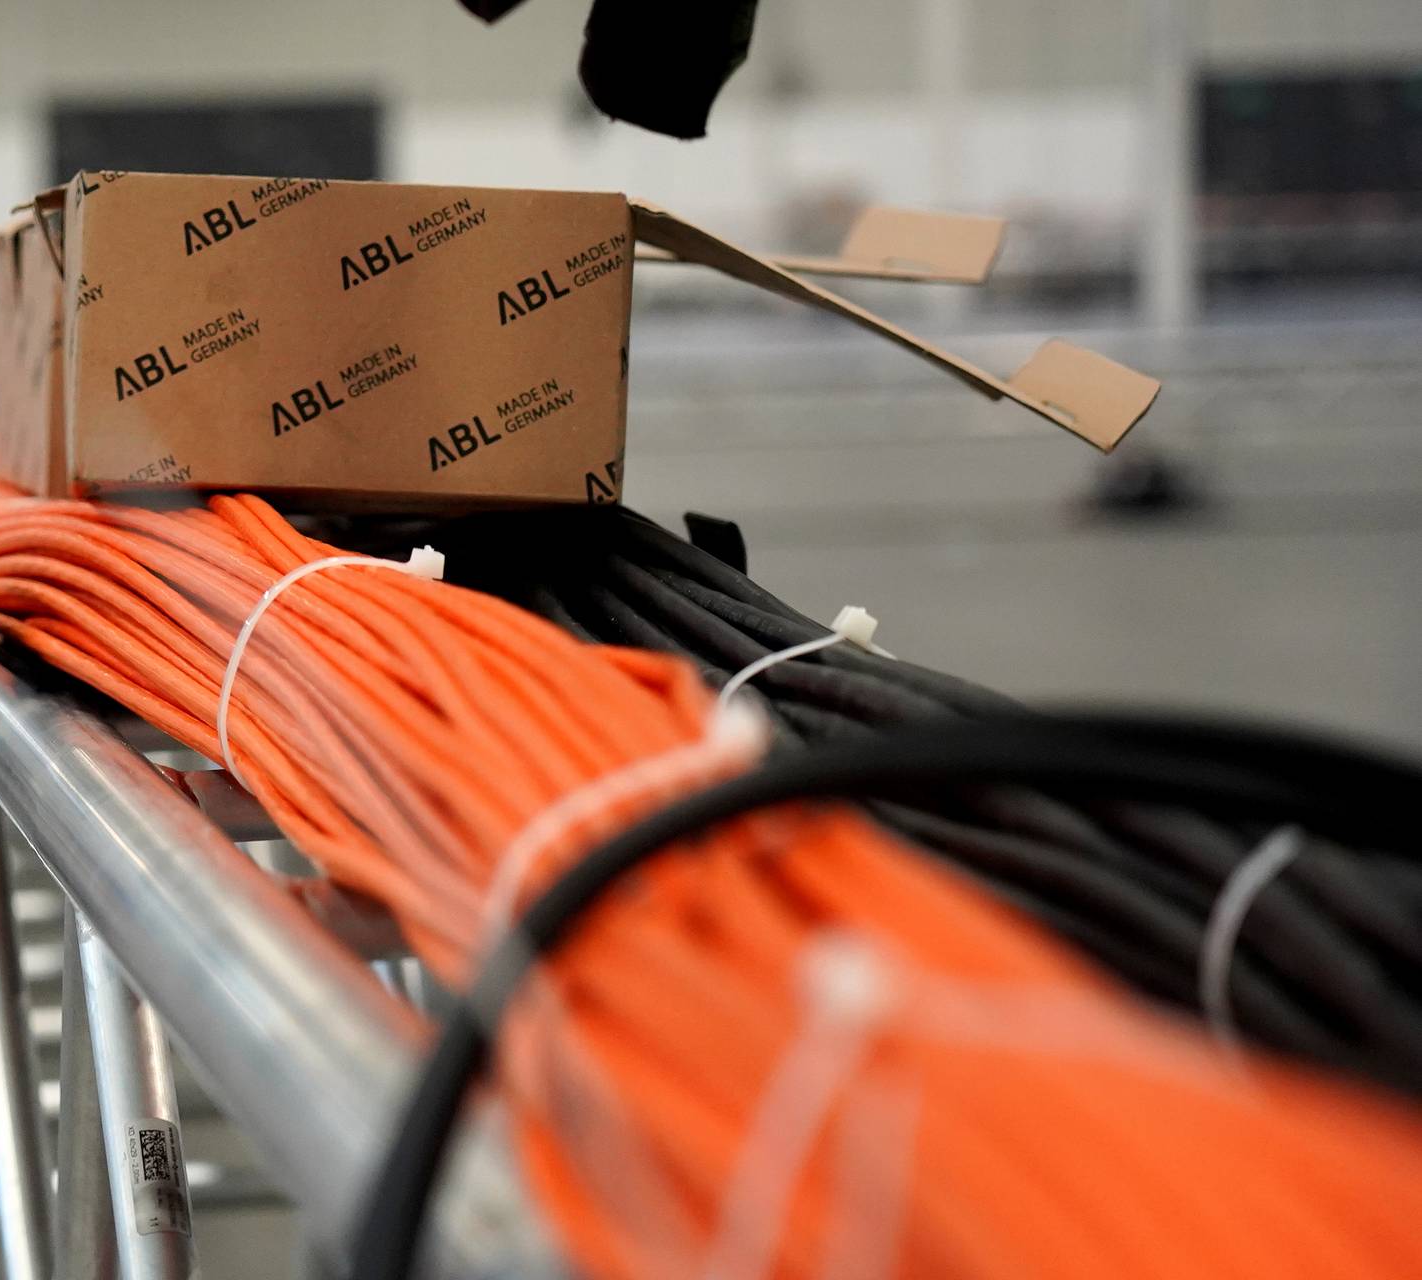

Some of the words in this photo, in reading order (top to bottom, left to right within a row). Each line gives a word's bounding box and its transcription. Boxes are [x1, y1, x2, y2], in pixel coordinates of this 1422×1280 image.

[183, 200, 257, 256] ABL
[408, 207, 454, 237] MADE
[455, 198, 472, 215] IN
[416, 209, 488, 252] GERMANY
[340, 234, 414, 290] ABL
[566, 241, 610, 272] MADE
[610, 233, 626, 250] IN
[497, 270, 570, 326] ABL
[182, 317, 228, 348] MADE
[228, 309, 245, 326] IN
[190, 319, 261, 363] GERMANY
[114, 345, 188, 402] ABL
[339, 352, 384, 383] MADE
[385, 343, 402, 361] IN
[347, 354, 418, 398] GERMANY
[272, 380, 345, 436] ABL
[496, 387, 541, 418] MADE
[542, 379, 559, 396] IN
[504, 389, 575, 433] GERMANY
[159, 454, 176, 471] IN
[428, 415, 502, 472] ABL
